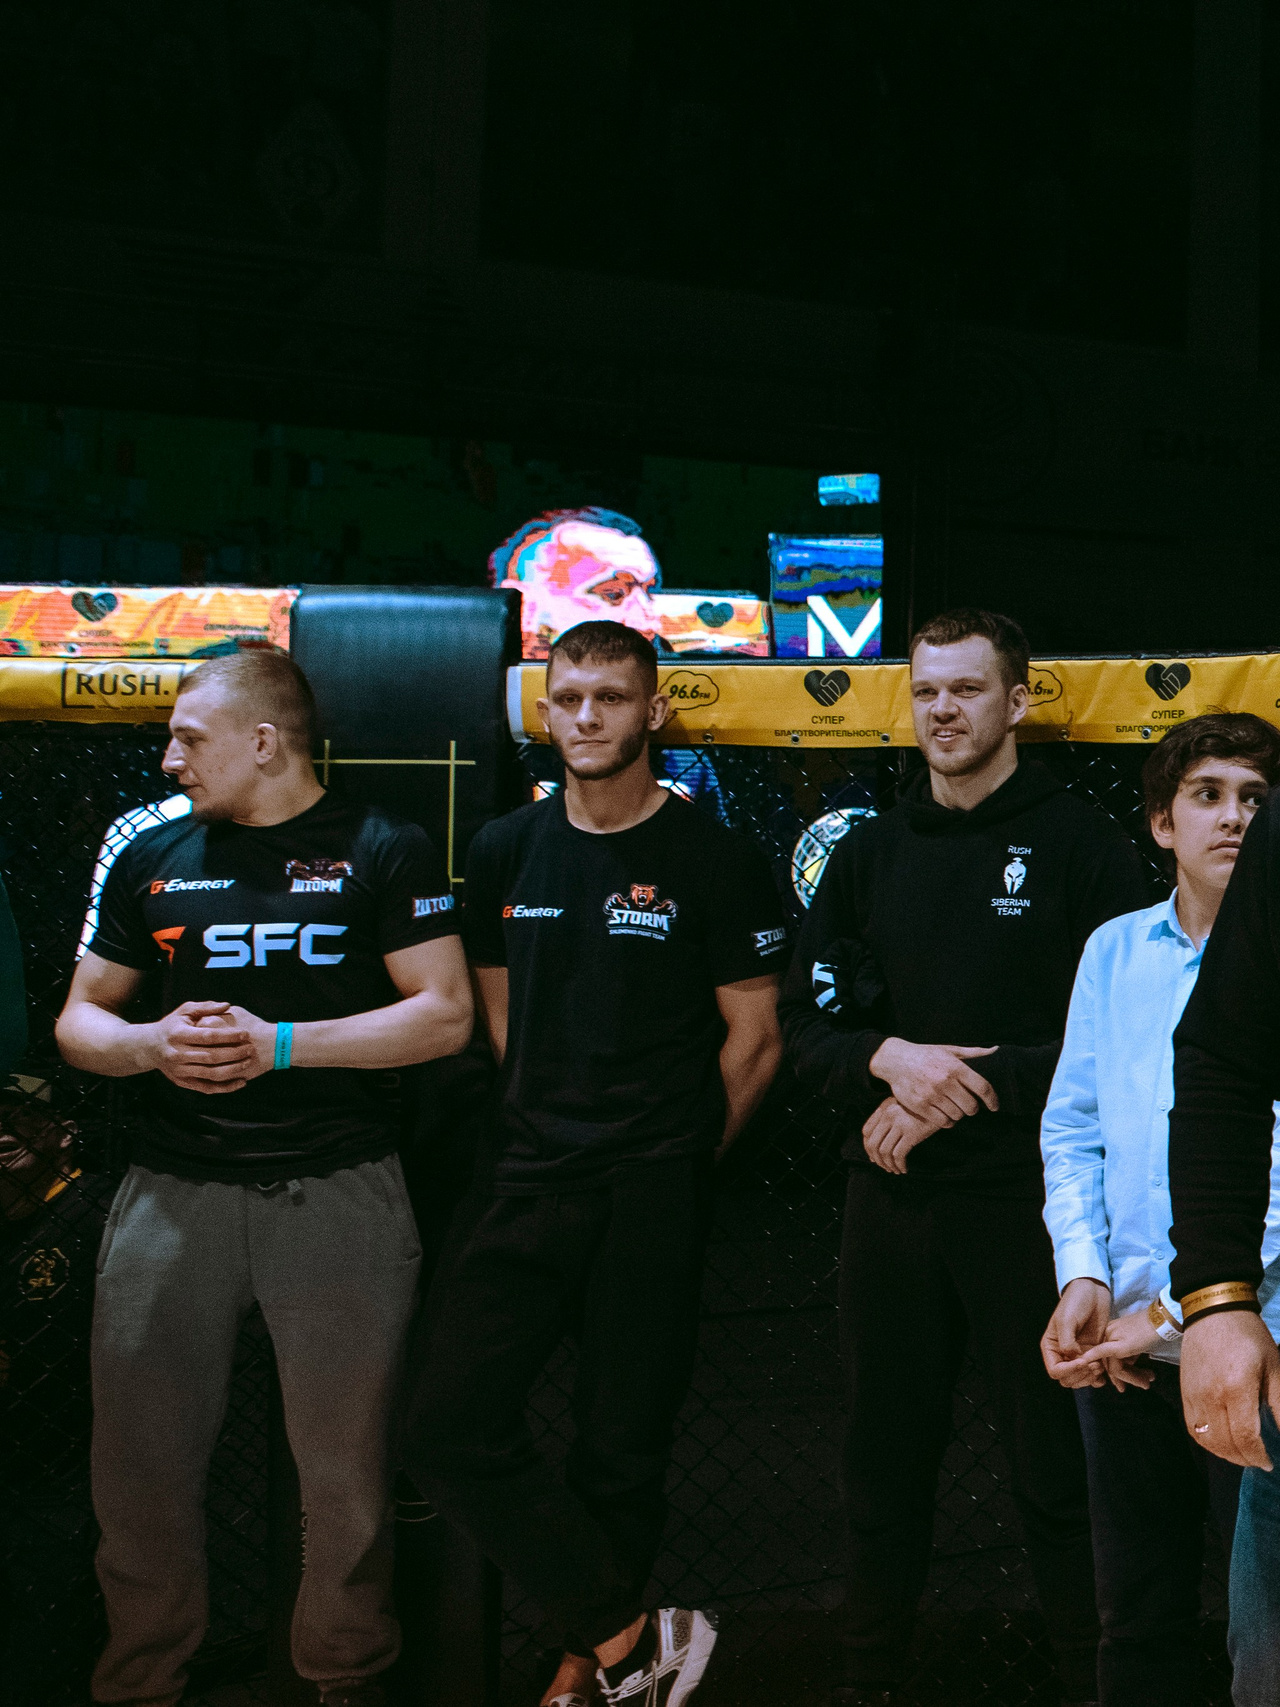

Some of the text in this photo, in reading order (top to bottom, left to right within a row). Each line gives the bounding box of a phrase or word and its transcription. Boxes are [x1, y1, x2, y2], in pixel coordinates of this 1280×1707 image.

[1151, 709, 1185, 719] СУПЕР
[811, 715, 845, 725] СУПЕР
[1007, 845, 1032, 855] RUSH
[991, 898, 1031, 907] SIBERIAN
[997, 907, 1022, 916] TEAM
[608, 908, 671, 932] STORM
[203, 923, 348, 969] SFC
